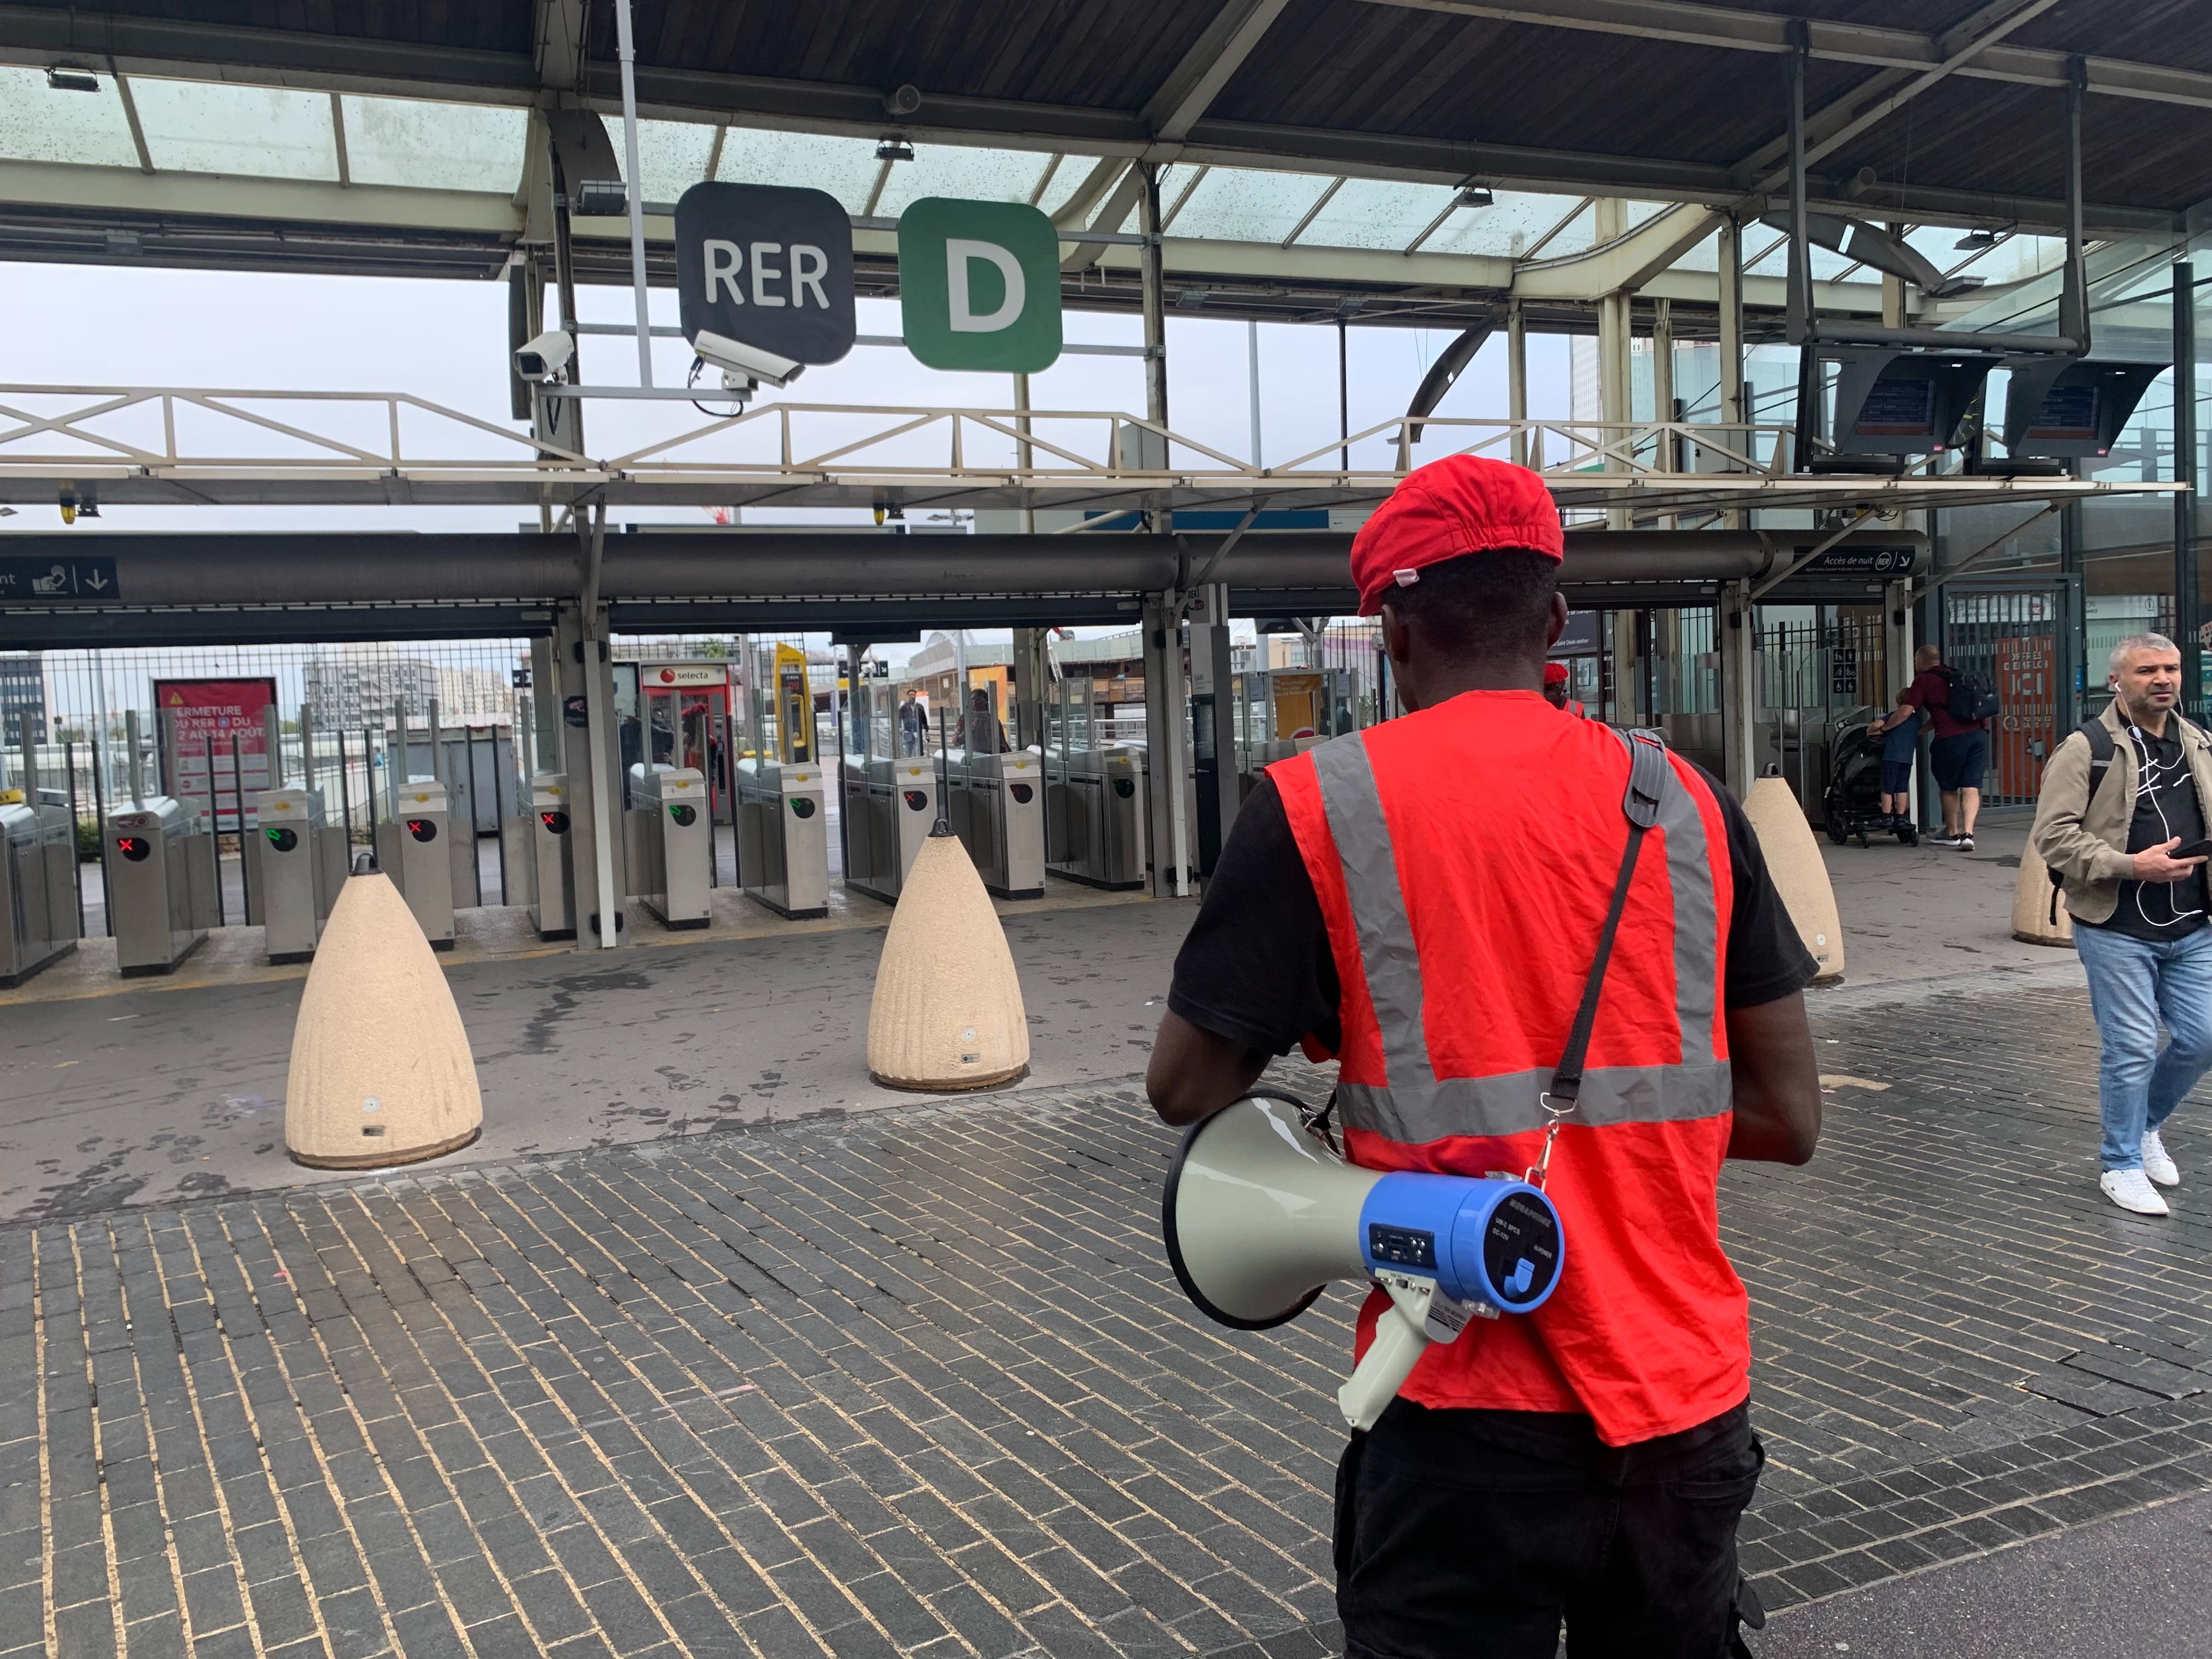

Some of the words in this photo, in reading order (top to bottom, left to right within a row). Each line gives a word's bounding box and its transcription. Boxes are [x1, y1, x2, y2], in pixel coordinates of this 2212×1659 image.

[703, 239, 830, 309] RER
[946, 238, 1025, 332] D
[1824, 556, 1846, 565] Accès
[1847, 556, 1857, 565] de
[1858, 556, 1874, 565] nuit
[678, 672, 708, 680] selecta
[2011, 672, 2042, 696] ICI
[174, 706, 242, 717] ERMETURE
[193, 718, 215, 728] RER
[232, 716, 251, 727] DU
[189, 730, 206, 740] AU
